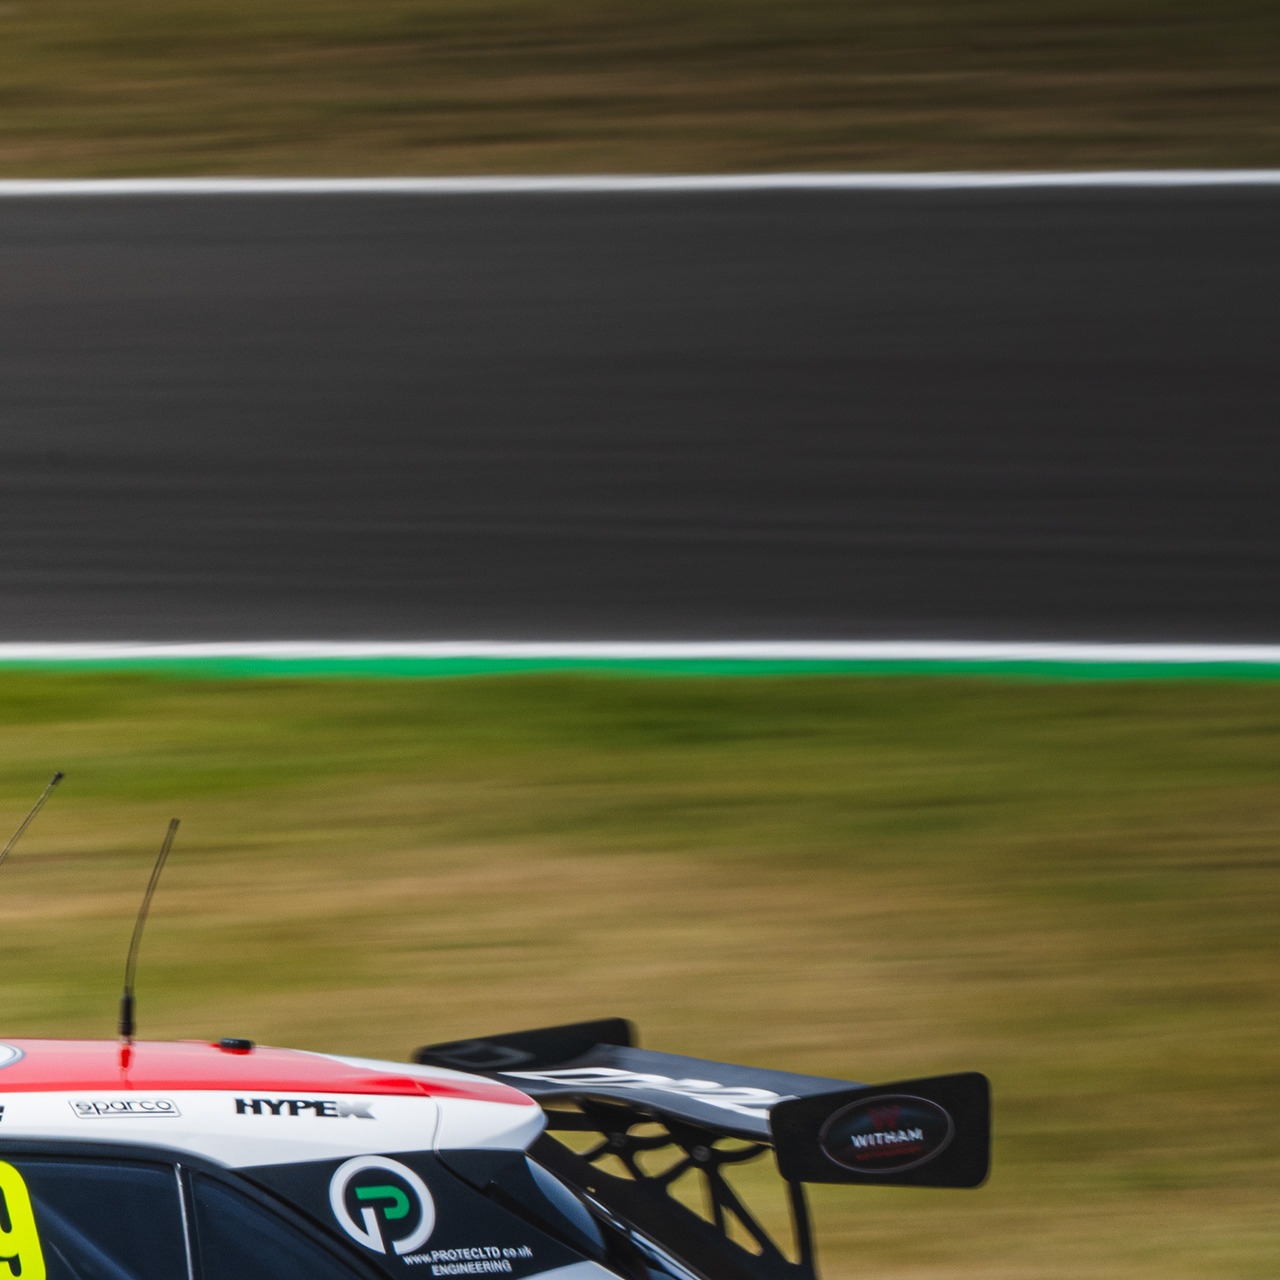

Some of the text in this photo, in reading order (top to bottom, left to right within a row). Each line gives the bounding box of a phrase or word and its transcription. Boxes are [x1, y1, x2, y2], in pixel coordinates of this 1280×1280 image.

[75, 1099, 173, 1117] sparco
[850, 1126, 924, 1149] WITHAM
[430, 1259, 513, 1277] ENGINEERING
